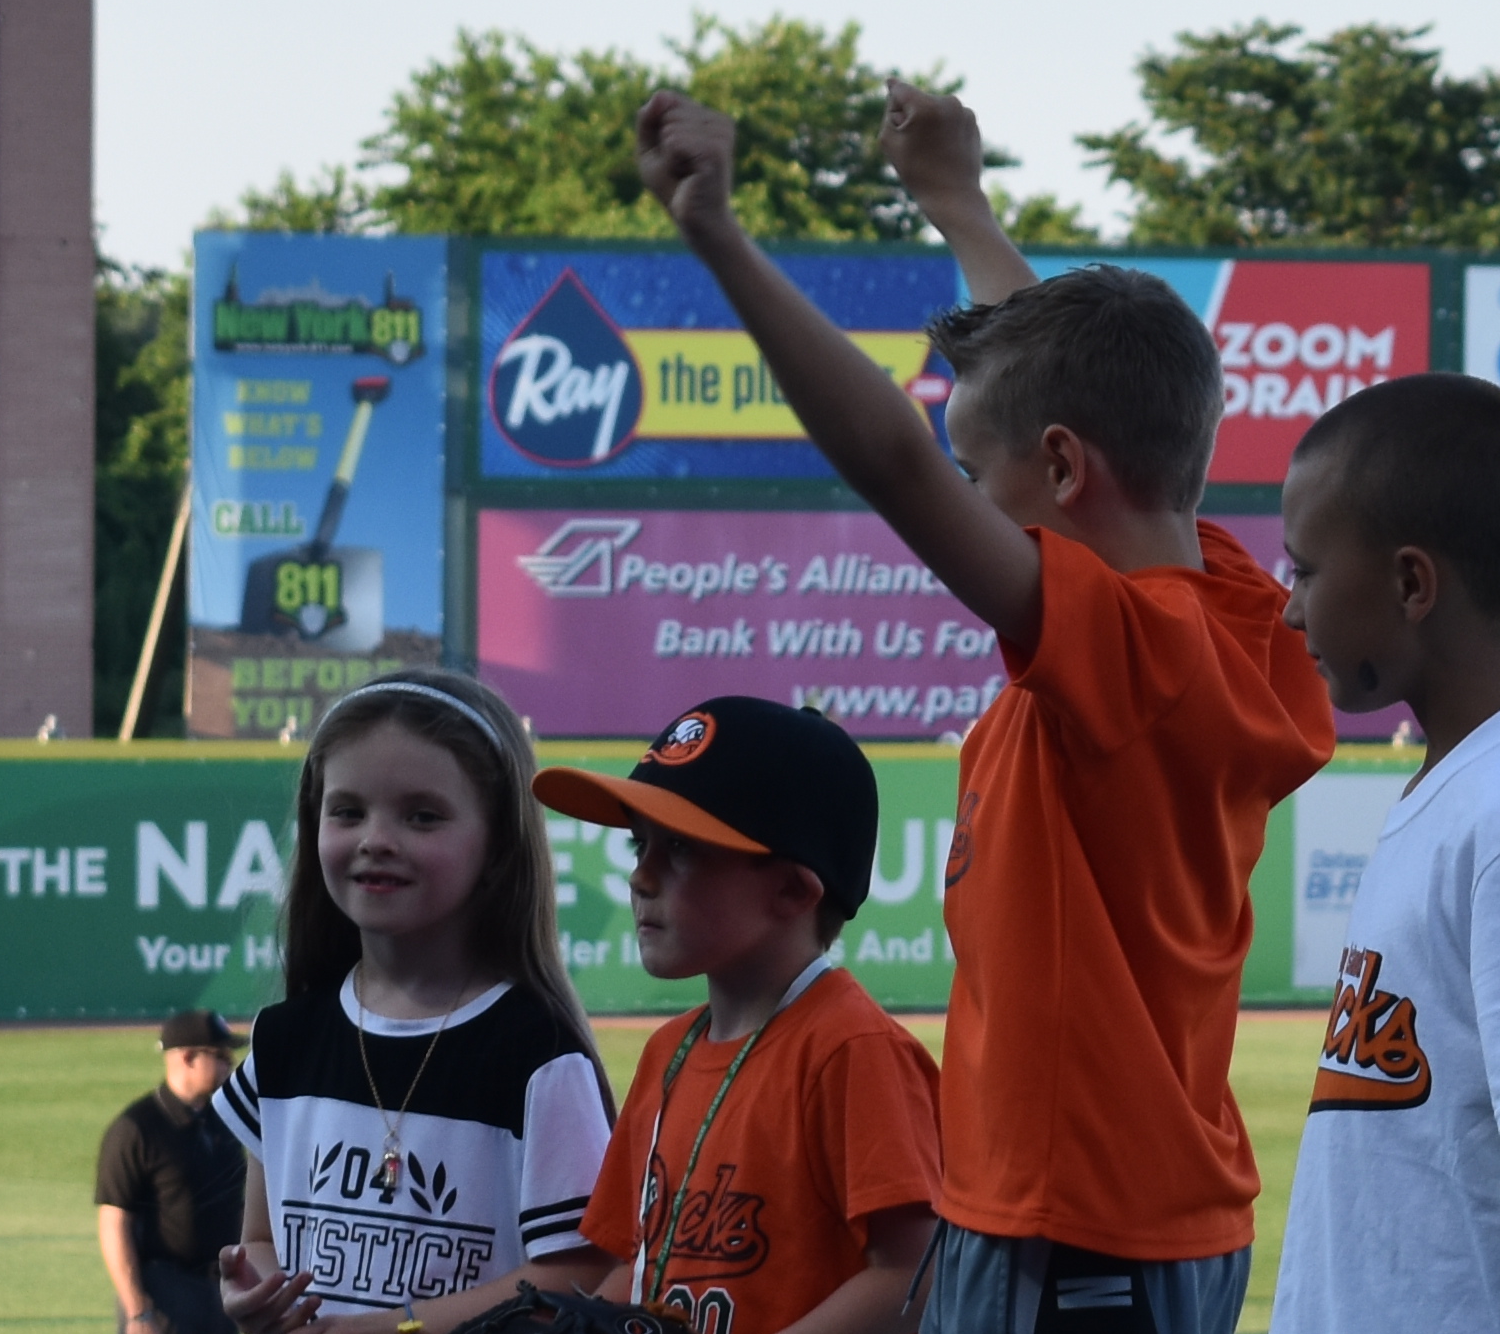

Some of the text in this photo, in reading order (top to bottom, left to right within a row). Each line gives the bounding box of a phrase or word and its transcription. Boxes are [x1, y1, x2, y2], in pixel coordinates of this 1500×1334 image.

[1219, 322, 1396, 370] ZOOM
[500, 333, 629, 463] Ray
[659, 353, 720, 405] the
[213, 502, 305, 536] CALL
[276, 561, 340, 614] 811
[617, 554, 789, 601] People's
[653, 618, 754, 658] Bank
[767, 619, 864, 657] With
[873, 620, 924, 658] Us
[230, 696, 314, 729] YOU
[136, 935, 231, 971] Your
[856, 928, 934, 963] And
